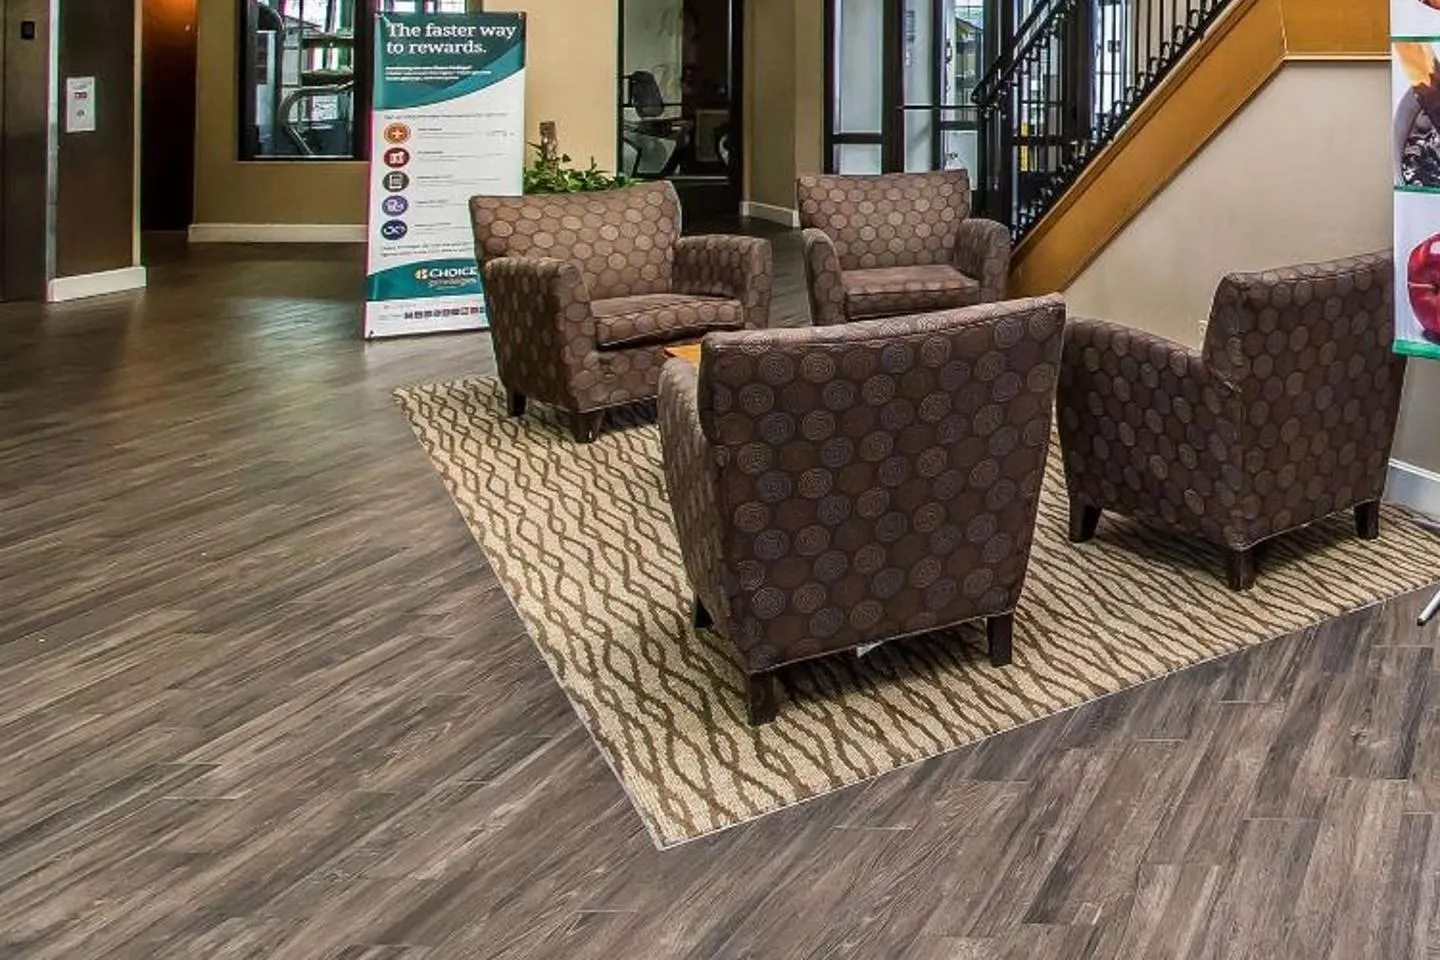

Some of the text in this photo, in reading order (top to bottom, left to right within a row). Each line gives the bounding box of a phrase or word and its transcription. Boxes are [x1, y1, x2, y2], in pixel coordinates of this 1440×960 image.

[388, 22, 517, 39] The faster way
[386, 40, 487, 54] to rewards.
[429, 266, 478, 279] CHOICE
